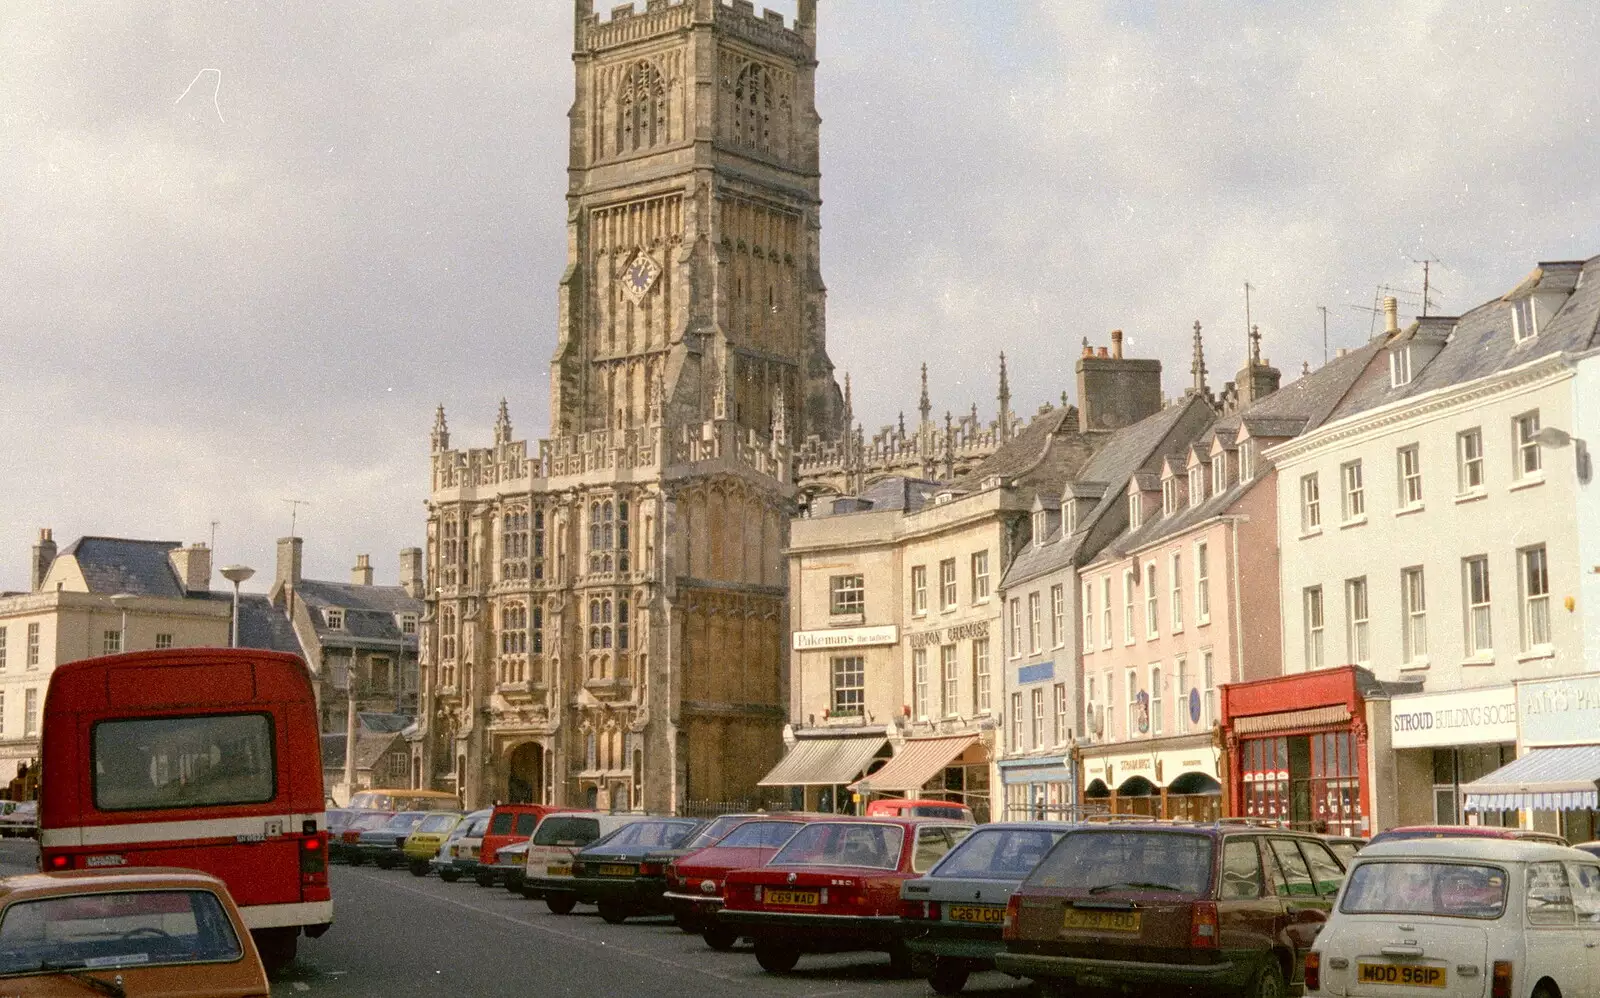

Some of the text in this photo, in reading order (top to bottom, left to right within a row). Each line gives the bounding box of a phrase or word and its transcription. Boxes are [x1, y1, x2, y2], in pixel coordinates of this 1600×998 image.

[948, 621, 989, 642] CHEMIST
[798, 634, 854, 647] Pakemans
[1394, 711, 1434, 732] STROUD
[1435, 706, 1481, 730] BUILDING
[770, 892, 791, 903] C69
[950, 907, 980, 921] C267
[1364, 966, 1440, 984] MDD 961P
